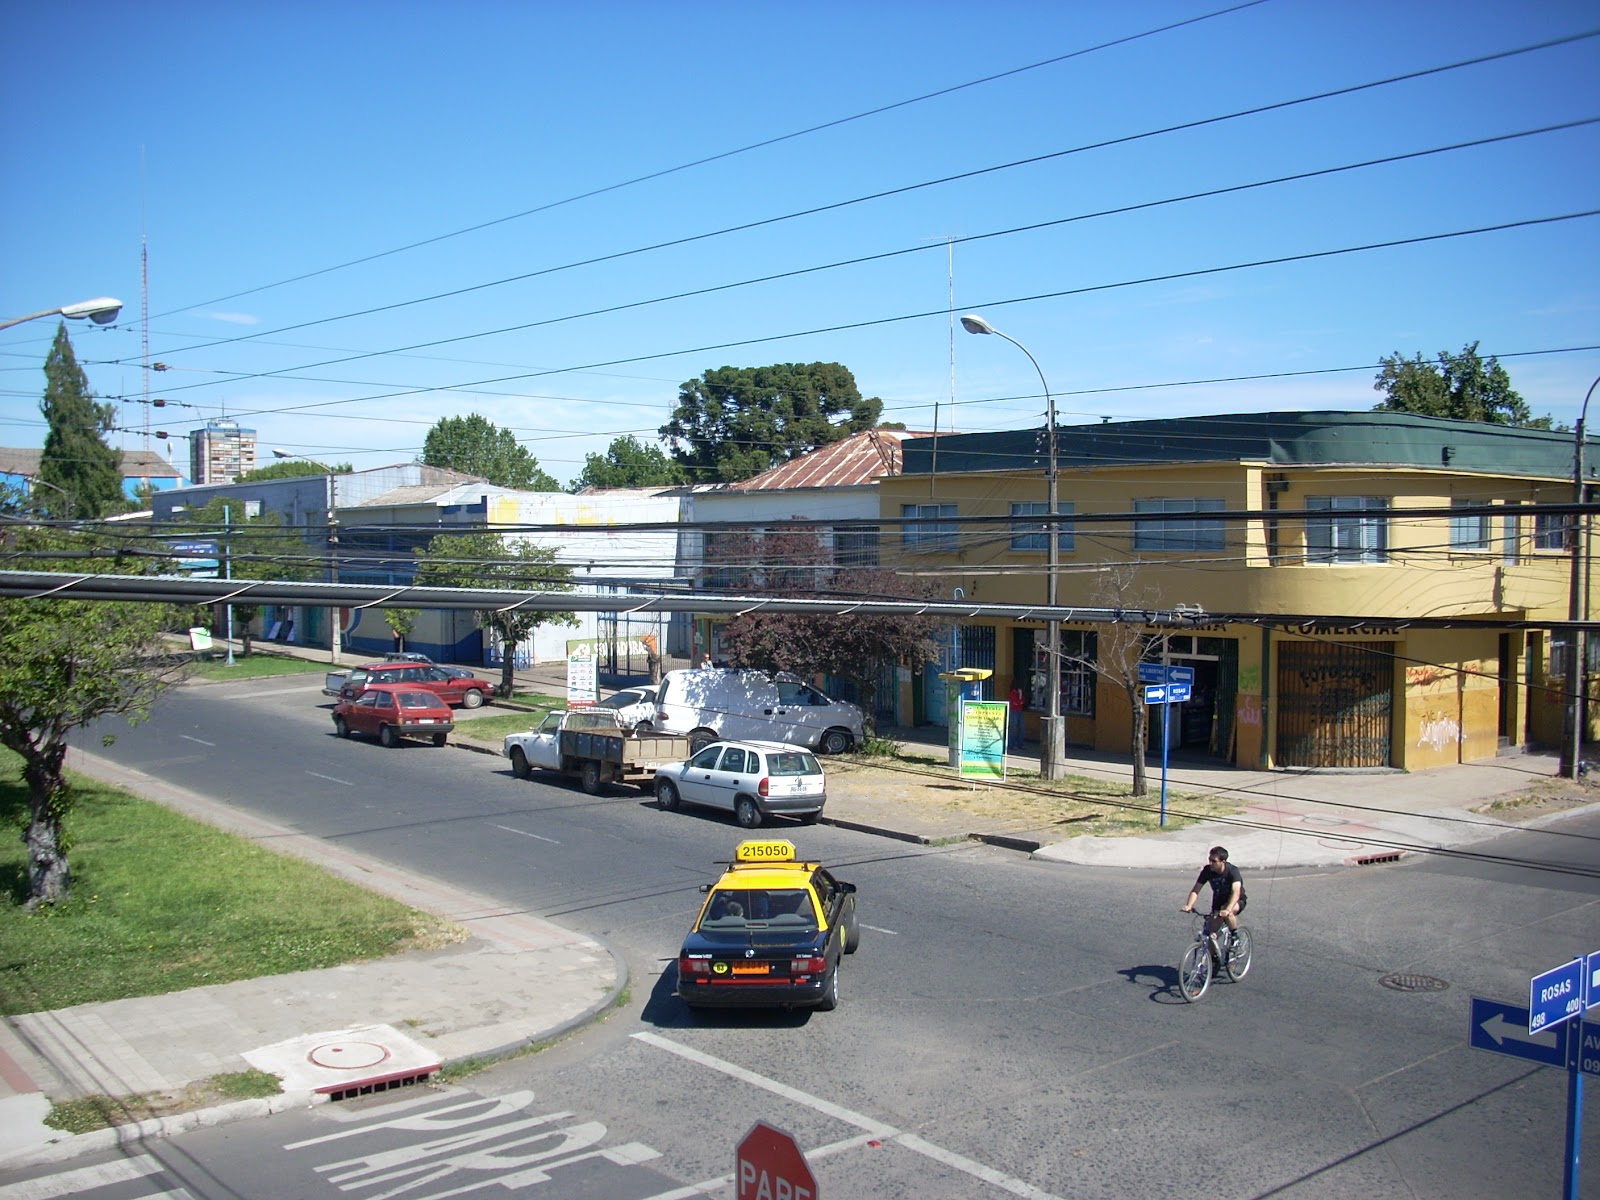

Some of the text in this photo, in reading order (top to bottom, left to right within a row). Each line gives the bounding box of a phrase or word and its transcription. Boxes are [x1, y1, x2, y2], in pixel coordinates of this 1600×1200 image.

[742, 845, 788, 857] 215050
[1541, 979, 1571, 1003] ROSAS
[1566, 998, 1579, 1013] 400
[1532, 1012, 1545, 1028] 498
